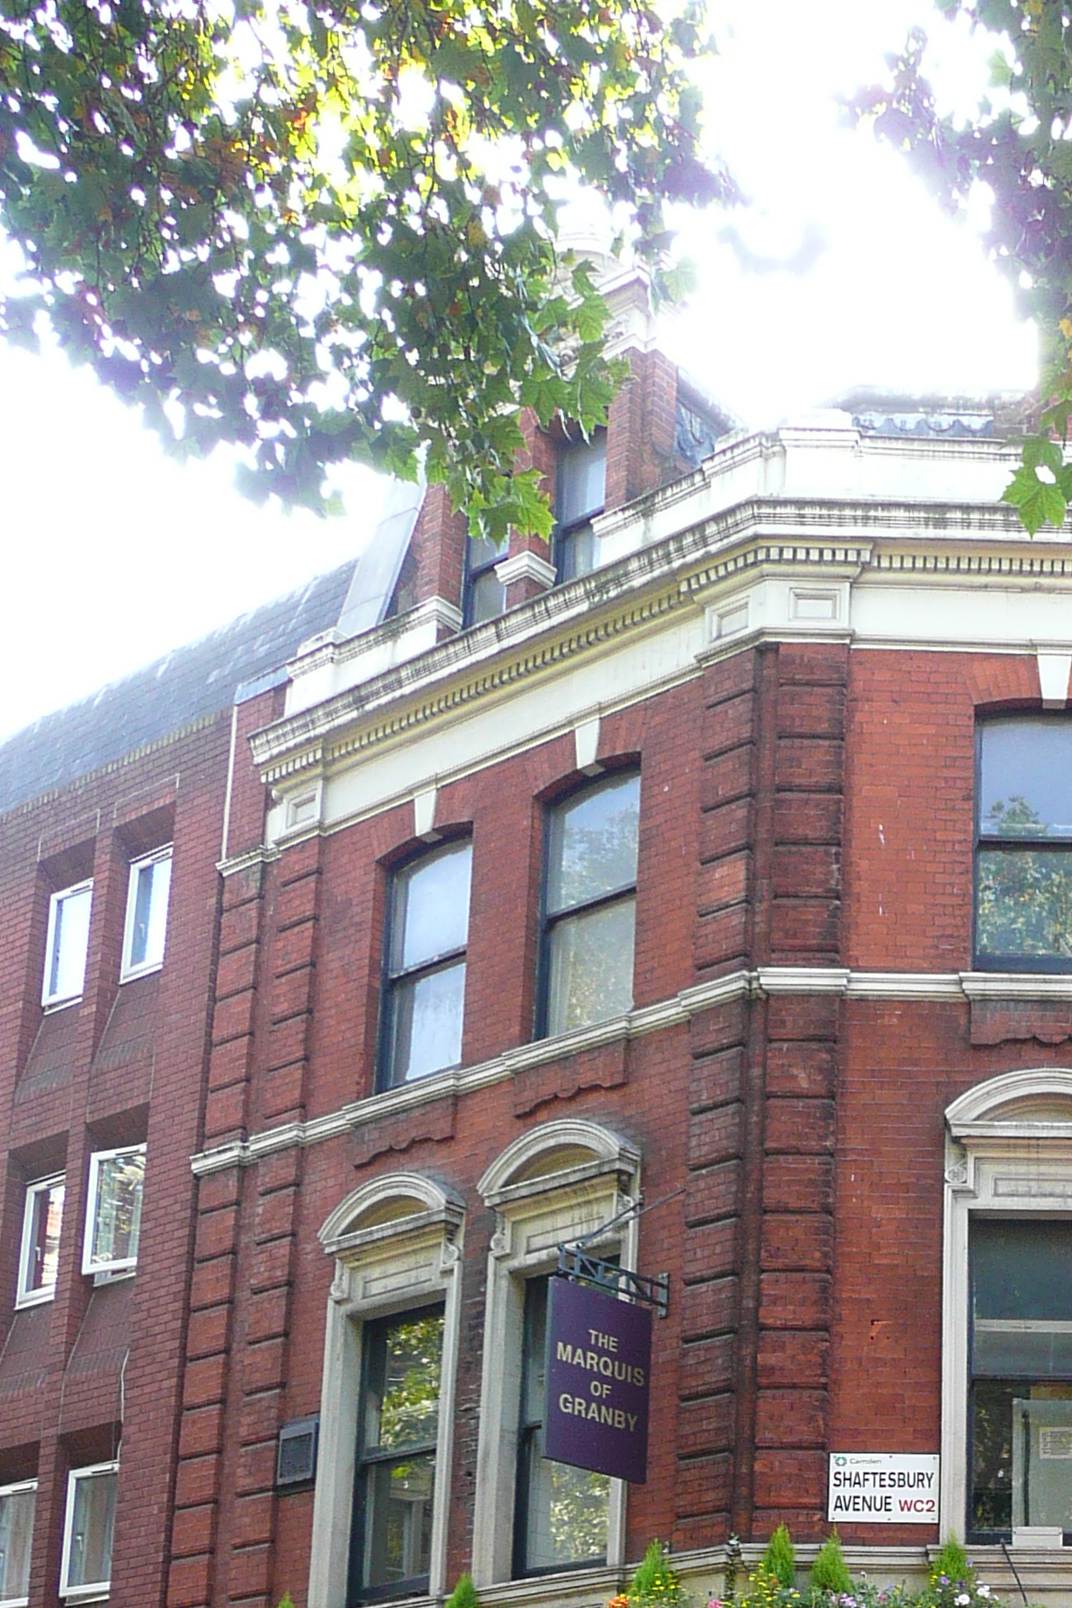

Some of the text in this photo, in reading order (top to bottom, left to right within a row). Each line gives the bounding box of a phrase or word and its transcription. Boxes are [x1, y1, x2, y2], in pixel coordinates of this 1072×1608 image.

[587, 1328, 619, 1352] THE
[556, 1341, 645, 1387] MARQUIS
[589, 1380, 612, 1399] OF
[558, 1393, 638, 1432] GRANBY
[832, 1471, 935, 1489] SHAFTESBURY
[833, 1495, 936, 1513] AVENUE WC2
